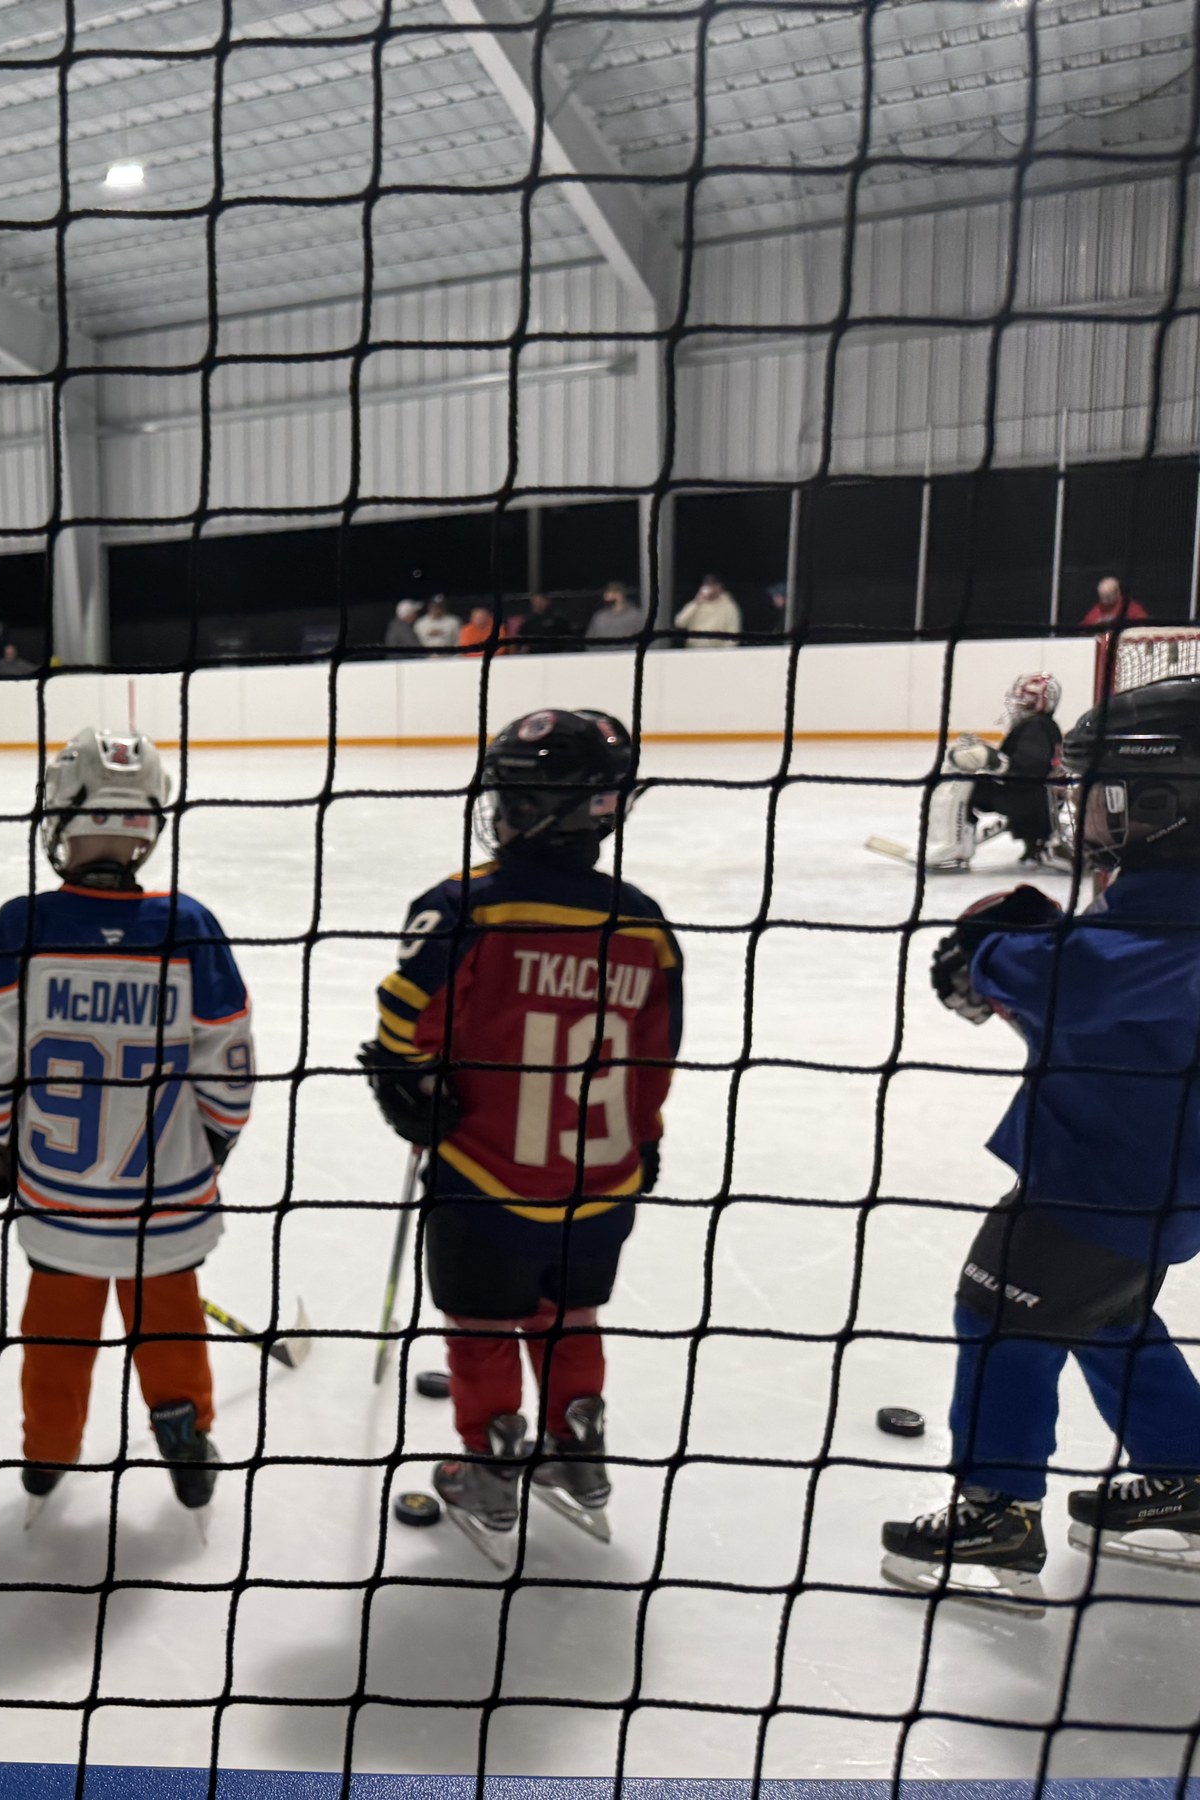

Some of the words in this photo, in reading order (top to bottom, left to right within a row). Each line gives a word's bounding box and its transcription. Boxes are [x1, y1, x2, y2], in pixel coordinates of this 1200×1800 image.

[47, 978, 179, 1027] McDAVID
[27, 1030, 192, 1182] 97
[514, 1011, 632, 1168] 19
